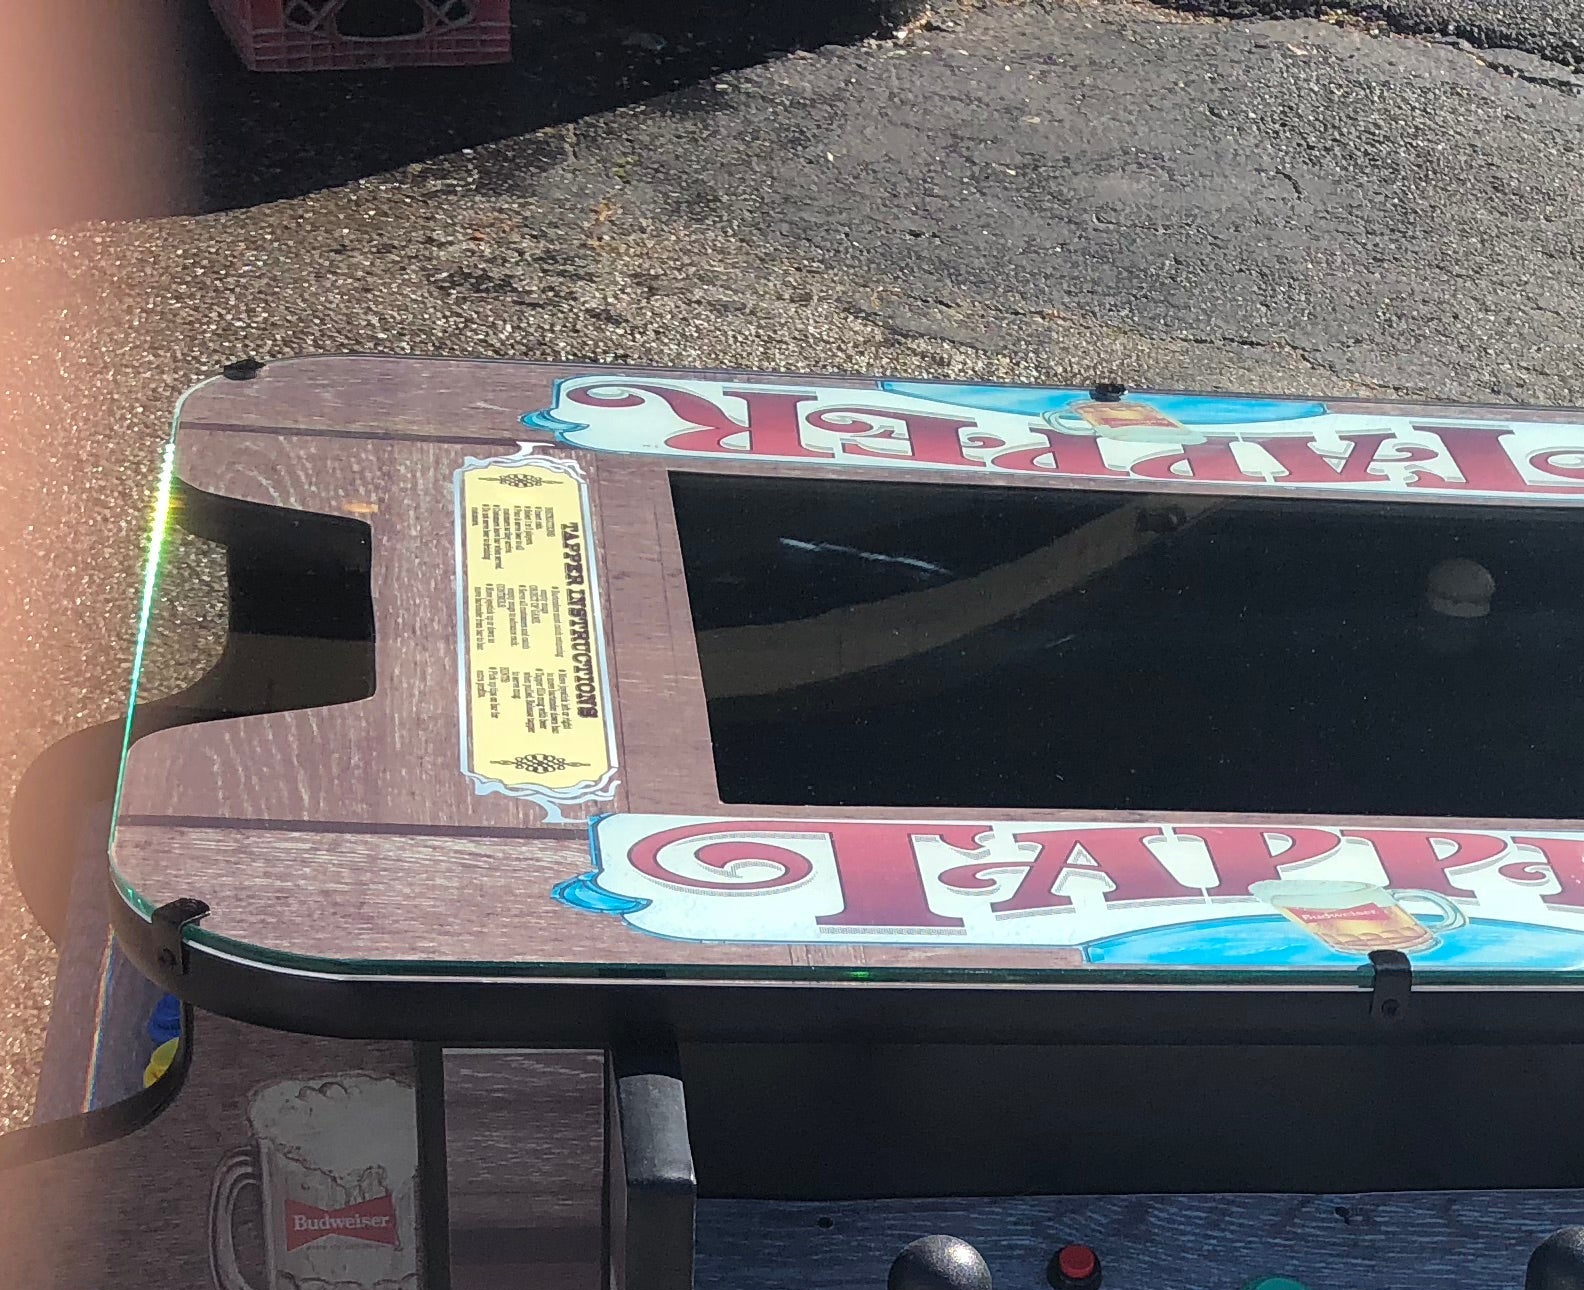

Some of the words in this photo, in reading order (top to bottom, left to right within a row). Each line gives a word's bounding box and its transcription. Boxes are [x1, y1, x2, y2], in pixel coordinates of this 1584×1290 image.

[559, 521, 585, 586] TAPPER
[564, 588, 599, 719] INSTRUCTIONS
[293, 1212, 391, 1231] Budweiser
